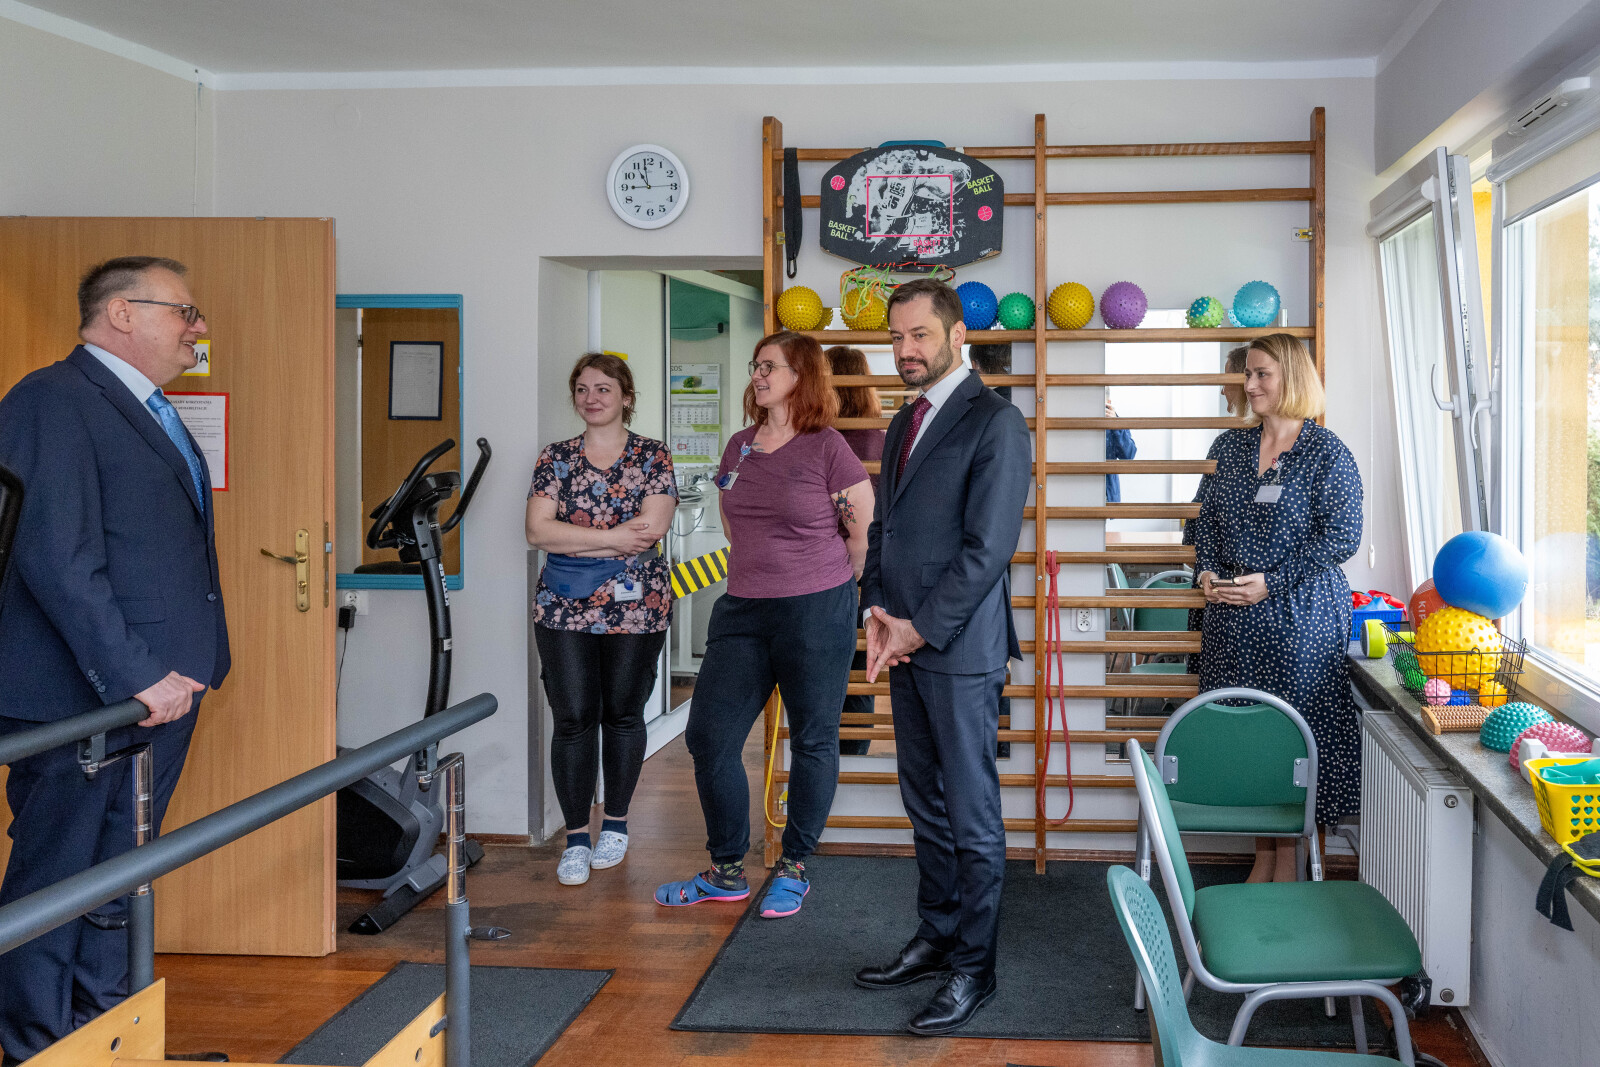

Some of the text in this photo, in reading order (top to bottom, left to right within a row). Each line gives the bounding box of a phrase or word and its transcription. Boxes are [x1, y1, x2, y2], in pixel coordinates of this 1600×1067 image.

[633, 162, 640, 170] 11
[643, 157, 655, 166] 12
[624, 172, 635, 180] 10
[666, 170, 674, 178] 2
[670, 182, 678, 191] 3
[966, 174, 995, 190] BASKET
[621, 183, 629, 192] 9
[890, 182, 906, 194] USA
[973, 184, 993, 196] BALL
[625, 195, 633, 204] 8
[666, 194, 673, 203] 4
[634, 205, 642, 213] 7
[646, 208, 654, 217] 6
[658, 204, 666, 213] 5
[828, 220, 857, 234] BASKET
[830, 229, 848, 241] BALL
[913, 239, 941, 247] BASKET
[917, 247, 936, 255] BALL
[438, 563, 450, 607] KETTLER
